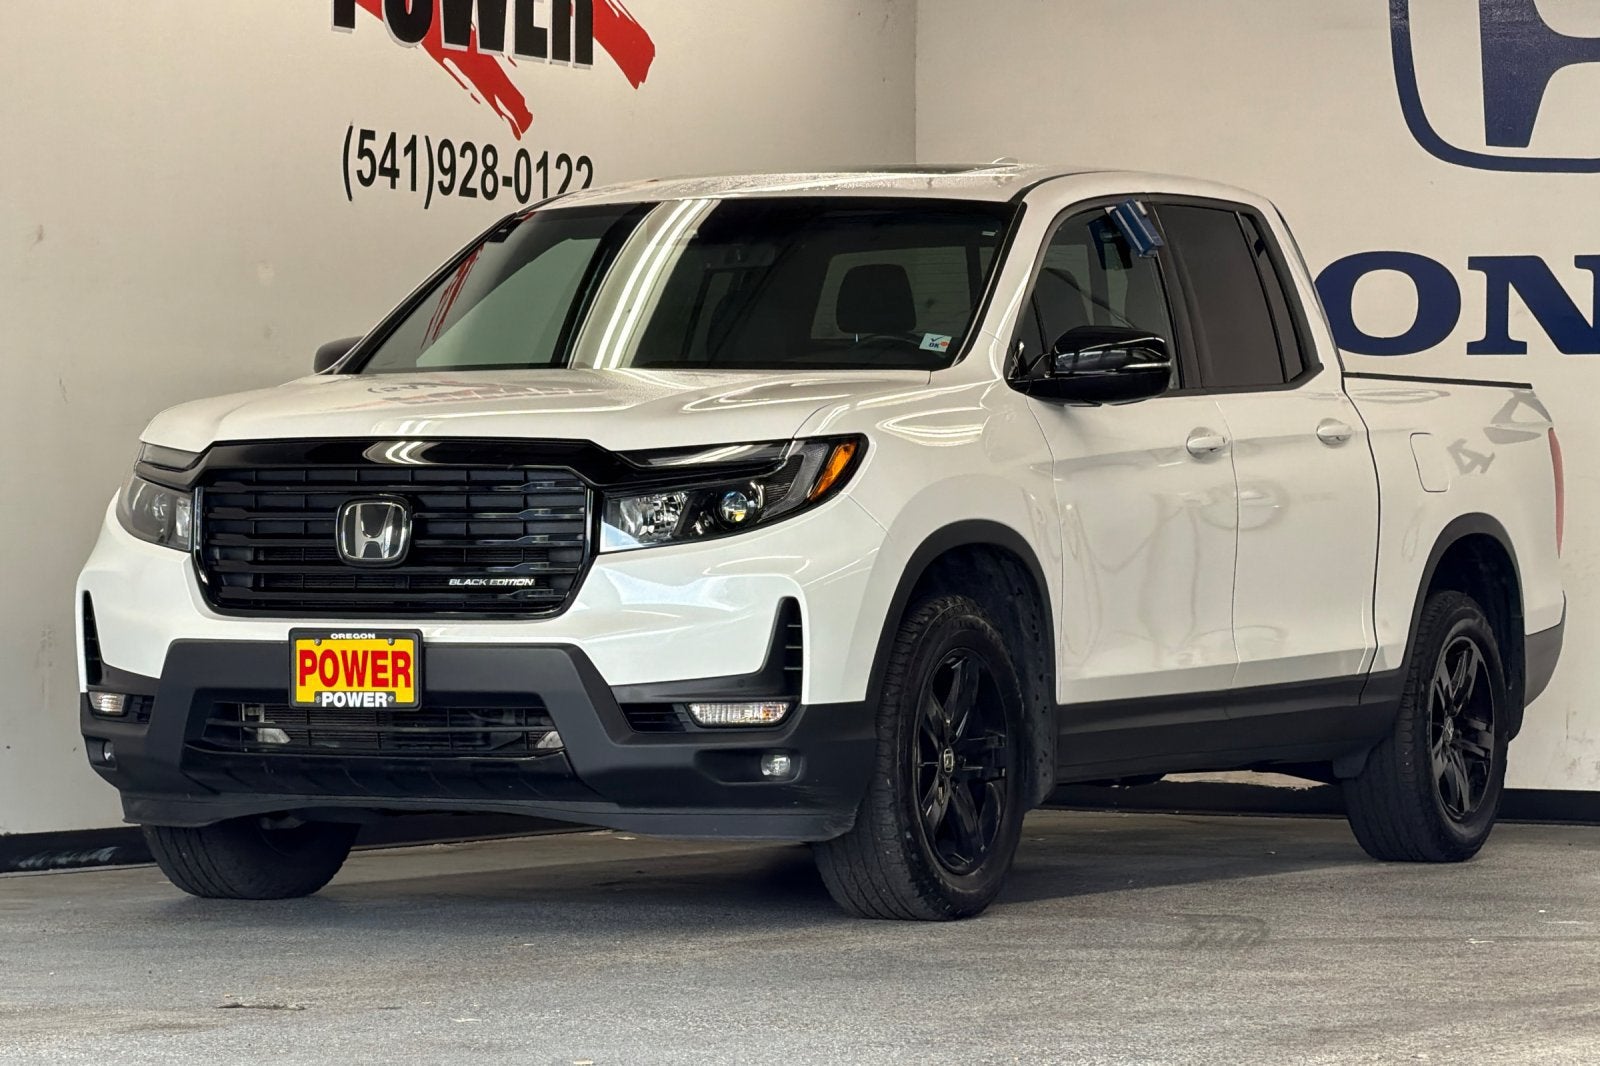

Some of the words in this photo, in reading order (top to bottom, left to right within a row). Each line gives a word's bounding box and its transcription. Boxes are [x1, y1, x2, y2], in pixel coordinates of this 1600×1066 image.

[448, 578, 488, 586] BLACK
[489, 578, 535, 586] EDITION
[330, 632, 376, 640] OREGON
[299, 648, 411, 688] POWER
[321, 691, 388, 708] POWER
